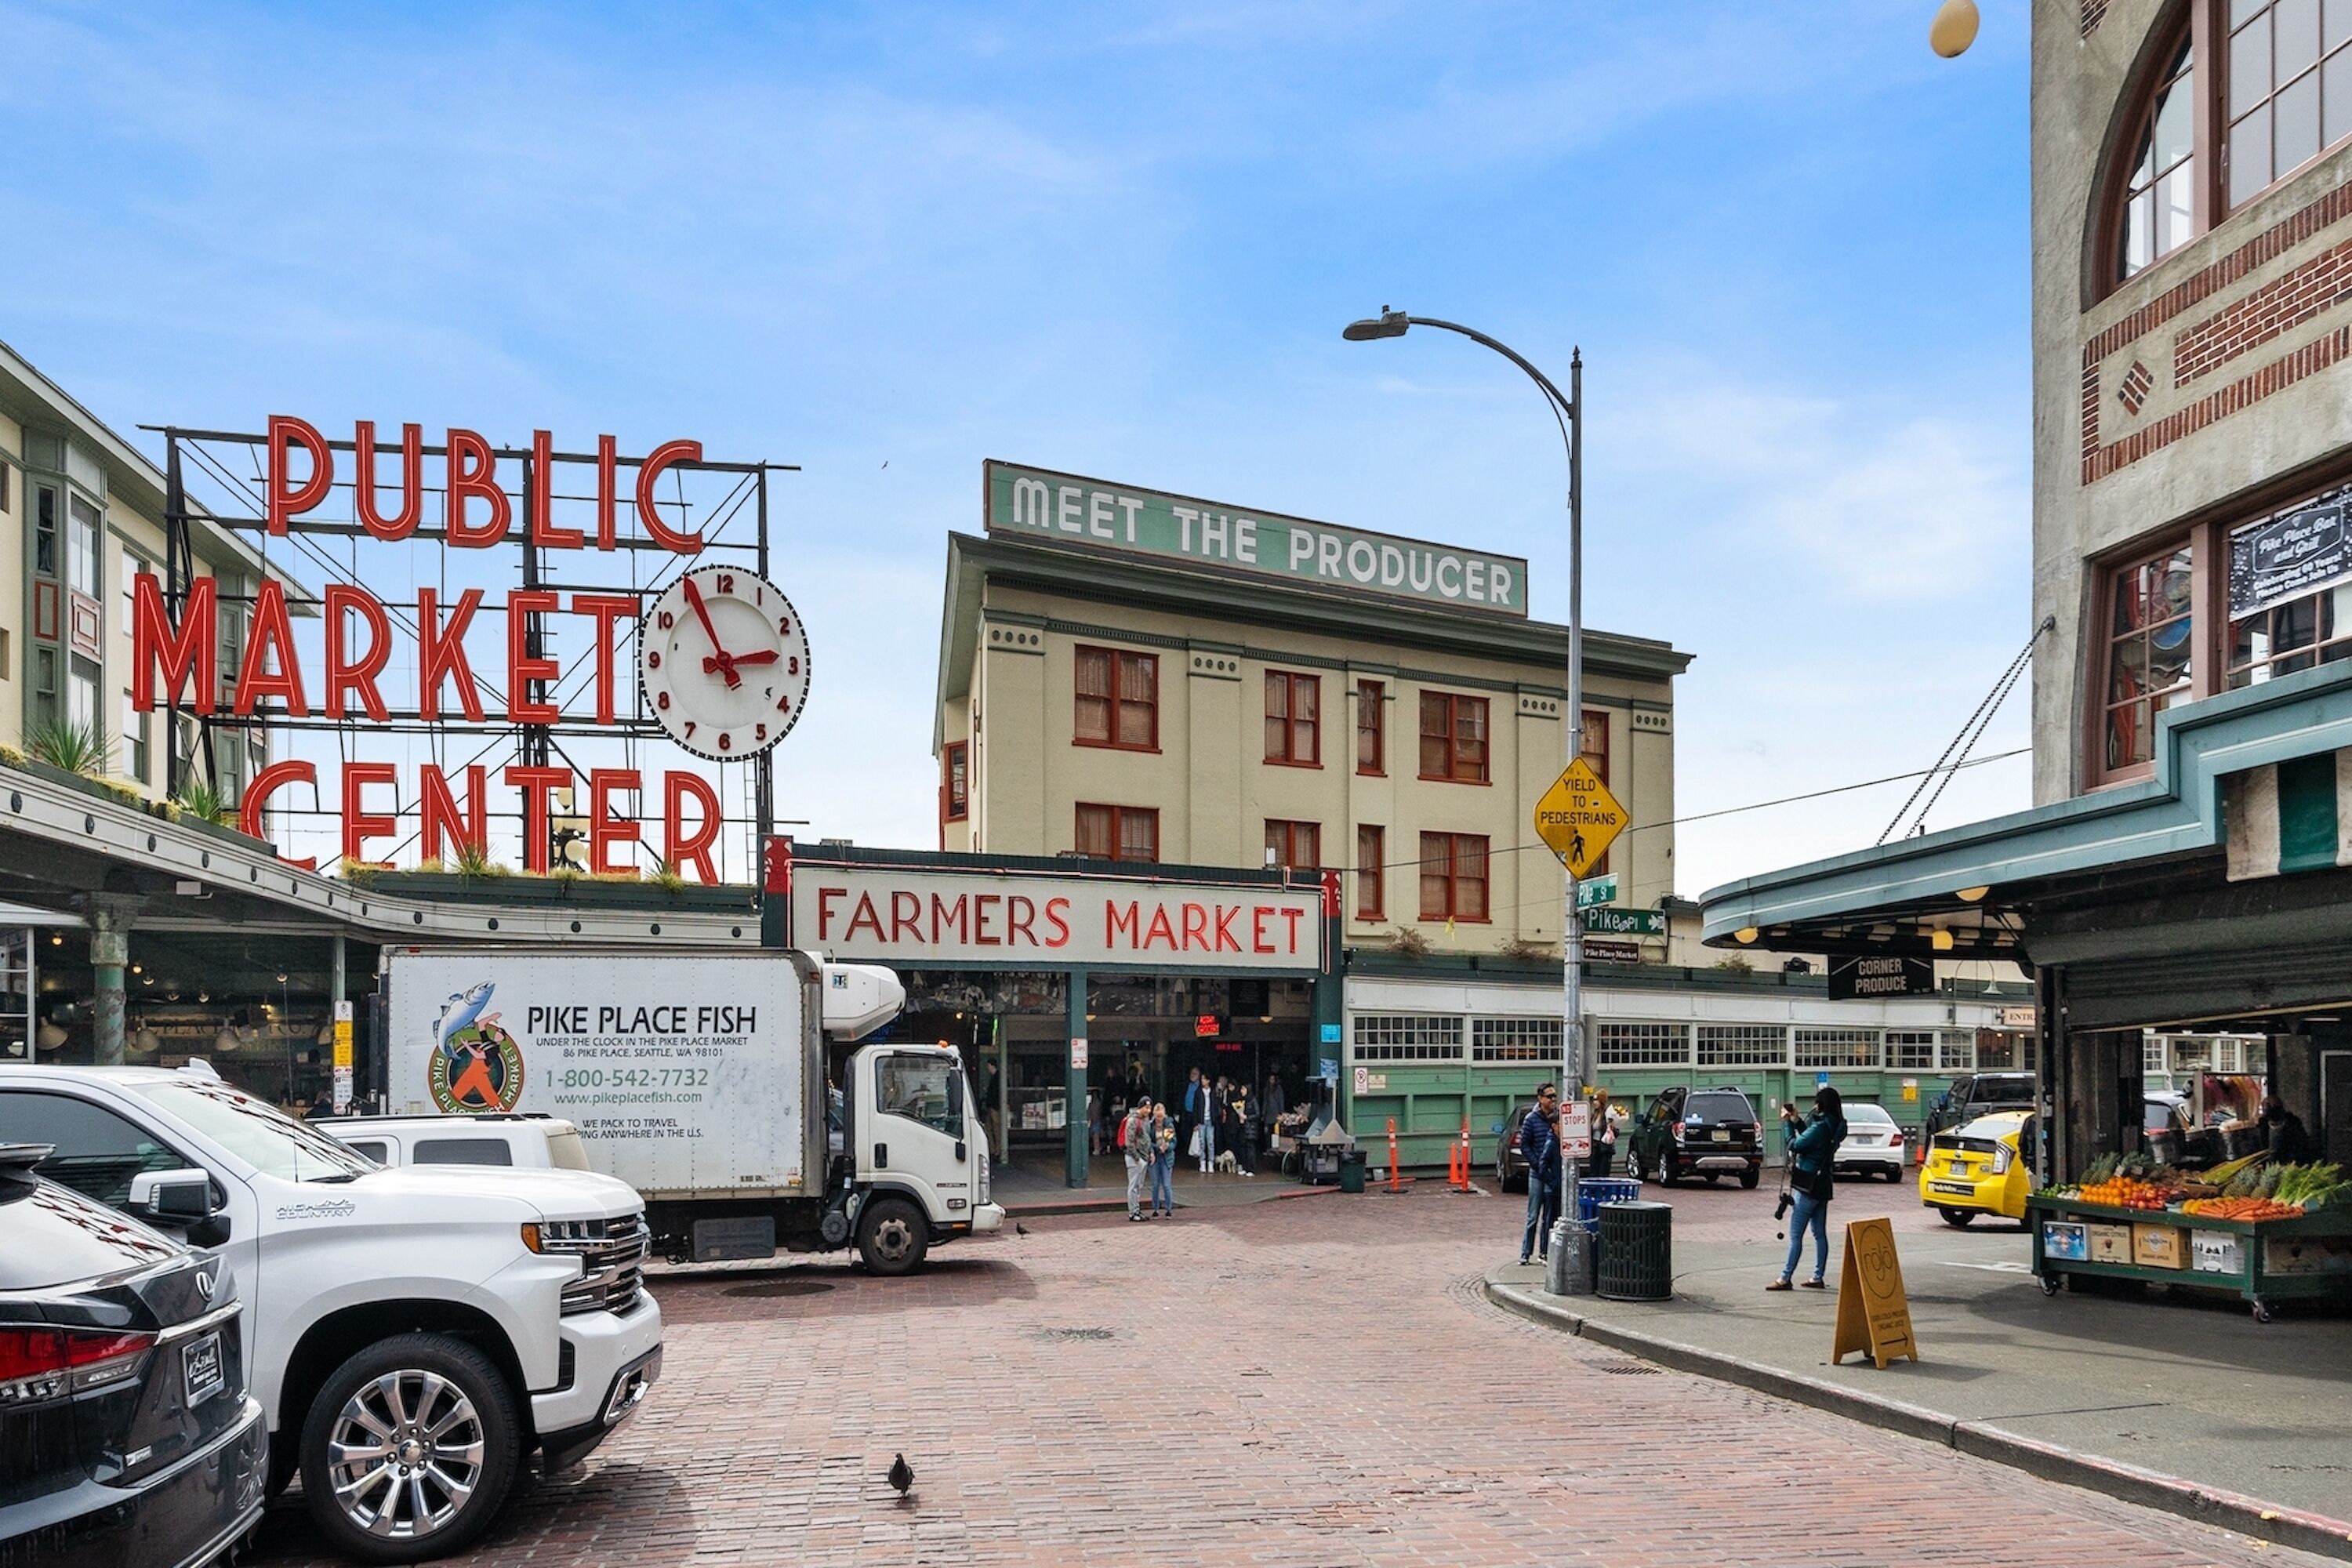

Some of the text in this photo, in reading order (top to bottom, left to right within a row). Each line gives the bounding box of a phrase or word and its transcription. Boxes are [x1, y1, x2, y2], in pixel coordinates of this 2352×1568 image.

[267, 414, 704, 555] PUBLIC
[1013, 477, 1512, 606] MEET THE PRODUCER
[717, 574, 733, 593] 12
[658, 612, 673, 630] 10
[779, 617, 790, 635] 2
[132, 572, 640, 725] MARKET
[649, 652, 660, 669] 9
[788, 656, 798, 674] 3
[658, 691, 670, 710] 8
[776, 695, 790, 713] 4
[684, 721, 696, 739] 7
[756, 724, 766, 741] 5
[718, 733, 731, 750] 6
[1563, 779, 1596, 791] YIELD
[1572, 795, 1586, 808] TO
[239, 760, 722, 886] CENTER
[1541, 811, 1617, 825] PEDESTRIANS
[818, 887, 1305, 954] FARMERS MARKET
[1588, 909, 1621, 930] Pike
[1858, 958, 1903, 976] CORNER
[1855, 976, 1907, 994] PRODUCE
[528, 1006, 757, 1034] PIKE PLACE FISH
[536, 1036, 748, 1047] UNDER THE CLOCK IN THE PIKE PLACE MARKET
[563, 1047, 723, 1058] 86 PIKE PLACE, SEATTLE, WA 98101
[433, 1057, 445, 1091] PIKE
[504, 1047, 520, 1103] MARKET
[546, 1069, 710, 1088] 1-800-542-7732
[554, 1091, 702, 1106] www.pikeplacefish.com
[583, 1118, 678, 1128] WE PACK TO TRAVEL
[1564, 1116, 1586, 1125] STOPS
[601, 1129, 652, 1138] ANYWHERE
[654, 1129, 664, 1138] IN
[667, 1129, 684, 1138] THE
[687, 1128, 704, 1138] U.S.
[276, 1210, 355, 1220] COUNTRY
